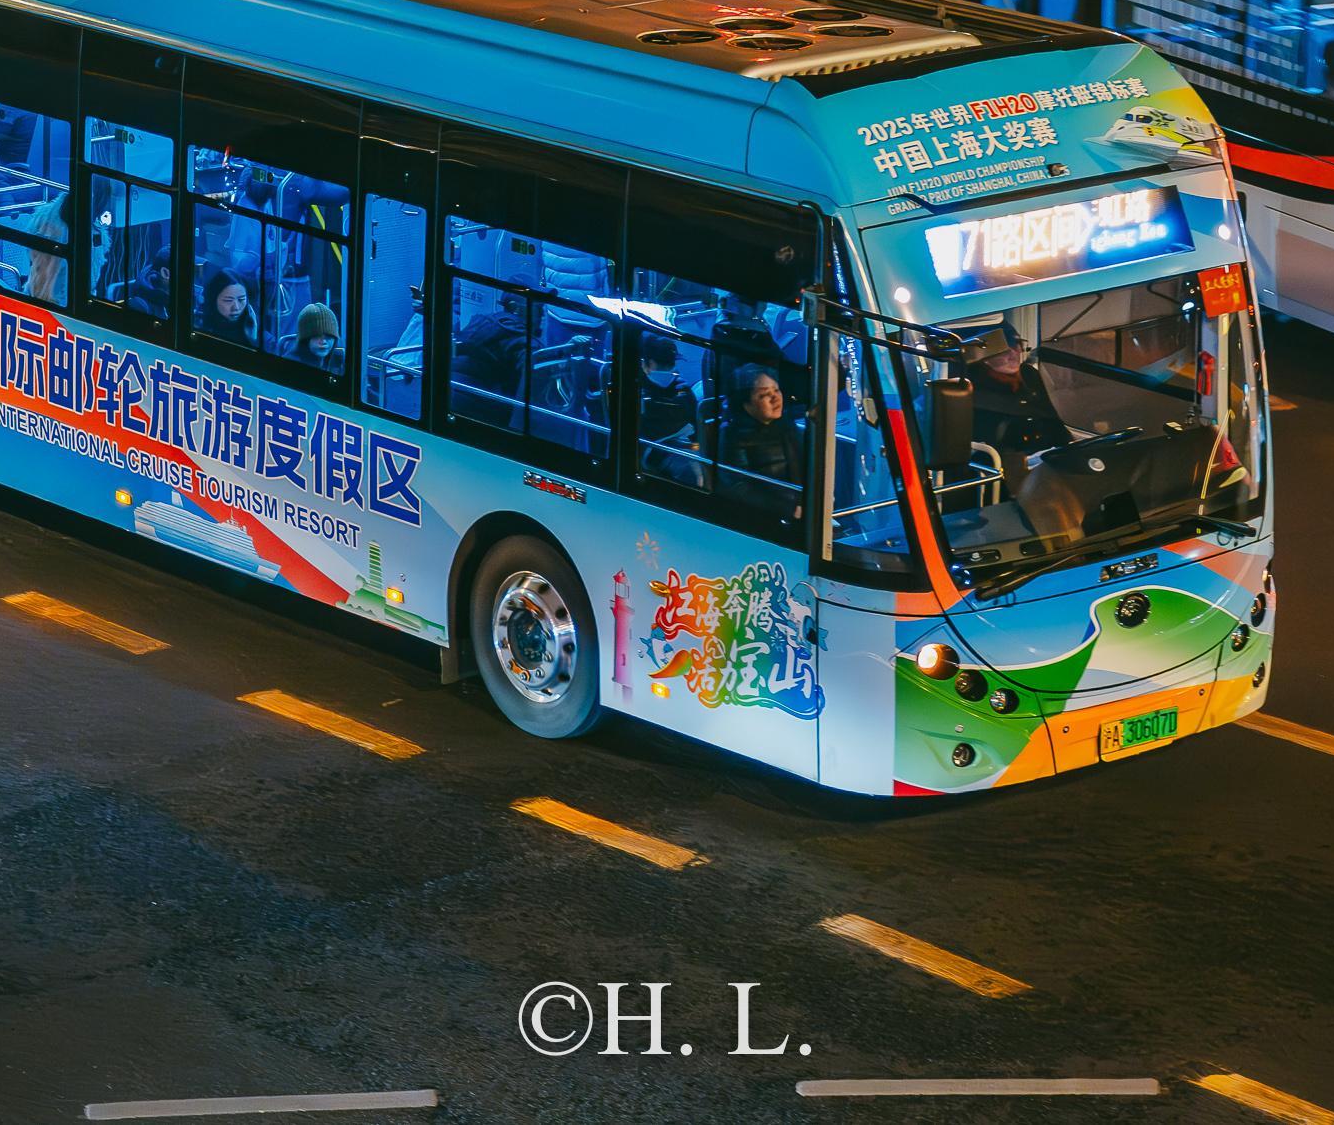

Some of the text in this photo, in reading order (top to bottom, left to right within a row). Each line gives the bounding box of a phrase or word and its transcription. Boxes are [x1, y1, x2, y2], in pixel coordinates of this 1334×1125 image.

[873, 117, 1059, 179] 中国上海大奖赛
[942, 168, 975, 186] WORLD
[976, 155, 1046, 179] CHAMPIONSHIP
[928, 188, 953, 204] PRIX
[952, 184, 966, 197] OF
[1017, 169, 1047, 184] CHINA
[127, 449, 194, 494] CRUISE
[197, 473, 279, 523] TOURISM
[283, 505, 361, 549] RESORT
